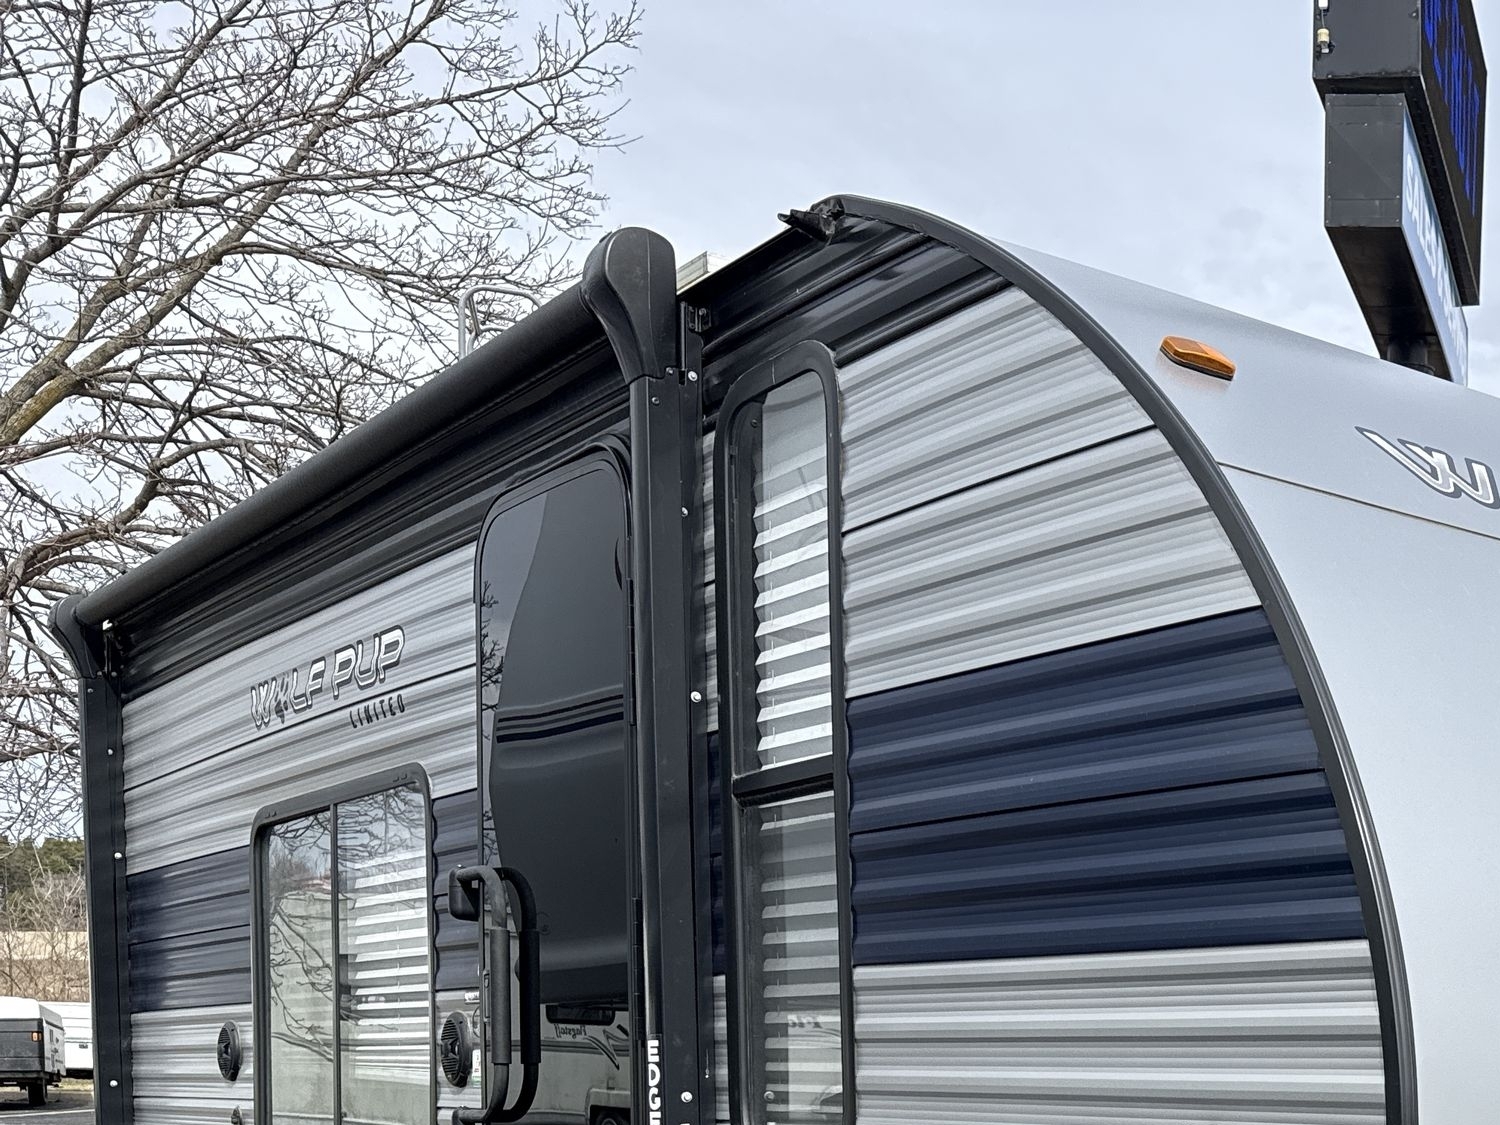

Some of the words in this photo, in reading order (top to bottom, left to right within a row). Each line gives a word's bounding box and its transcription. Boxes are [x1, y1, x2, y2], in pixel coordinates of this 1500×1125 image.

[1406, 152, 1437, 279] SALES
[251, 656, 326, 731] WLF
[331, 625, 405, 700] PUP
[350, 693, 405, 729] LIMITED
